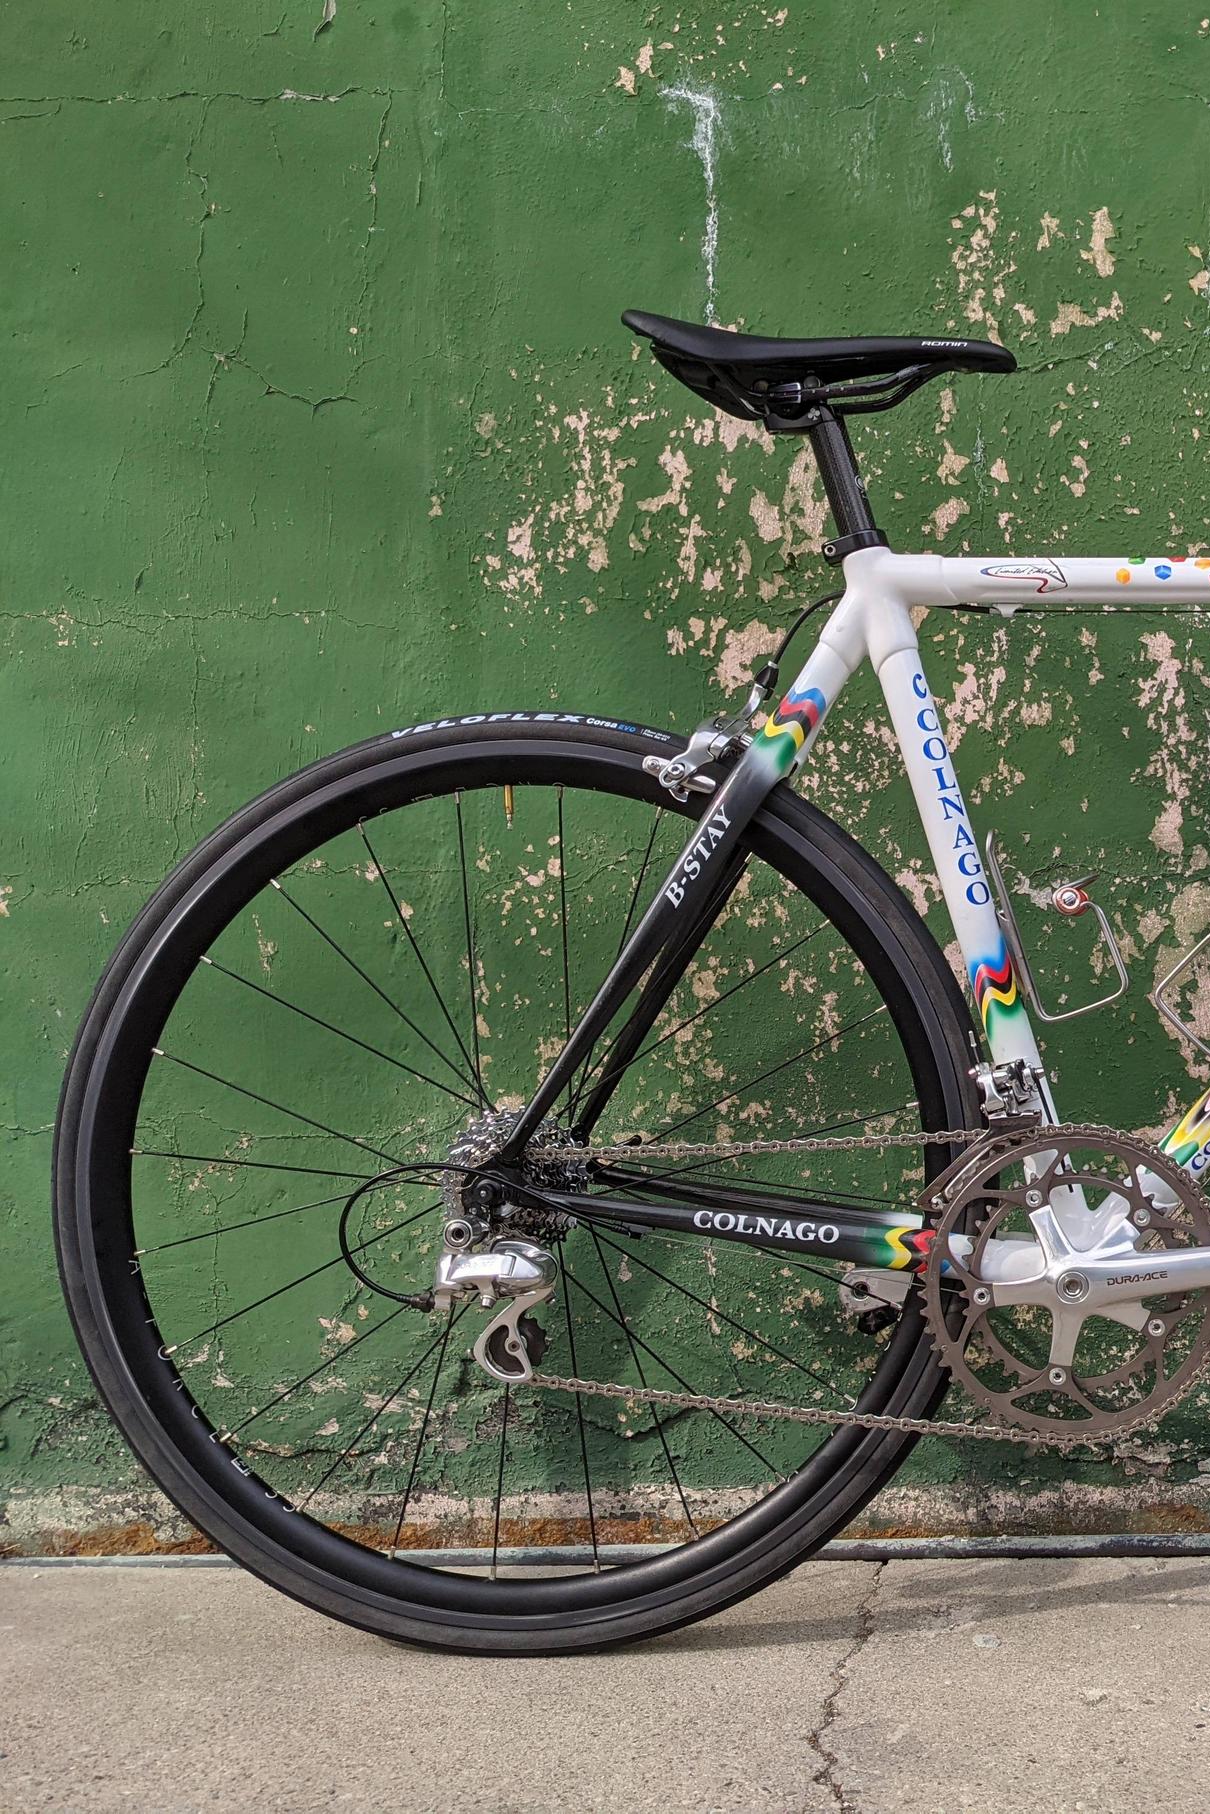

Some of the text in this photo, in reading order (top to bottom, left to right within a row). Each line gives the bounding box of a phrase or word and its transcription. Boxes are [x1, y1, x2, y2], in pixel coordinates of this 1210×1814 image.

[392, 713, 636, 738] VELOFLEX Corsa EVO
[917, 708, 990, 906] COLNAGO
[665, 803, 731, 909] B-STAY
[693, 1210, 840, 1244] COLNAGO
[1106, 1270, 1169, 1286] DURA-ACE
